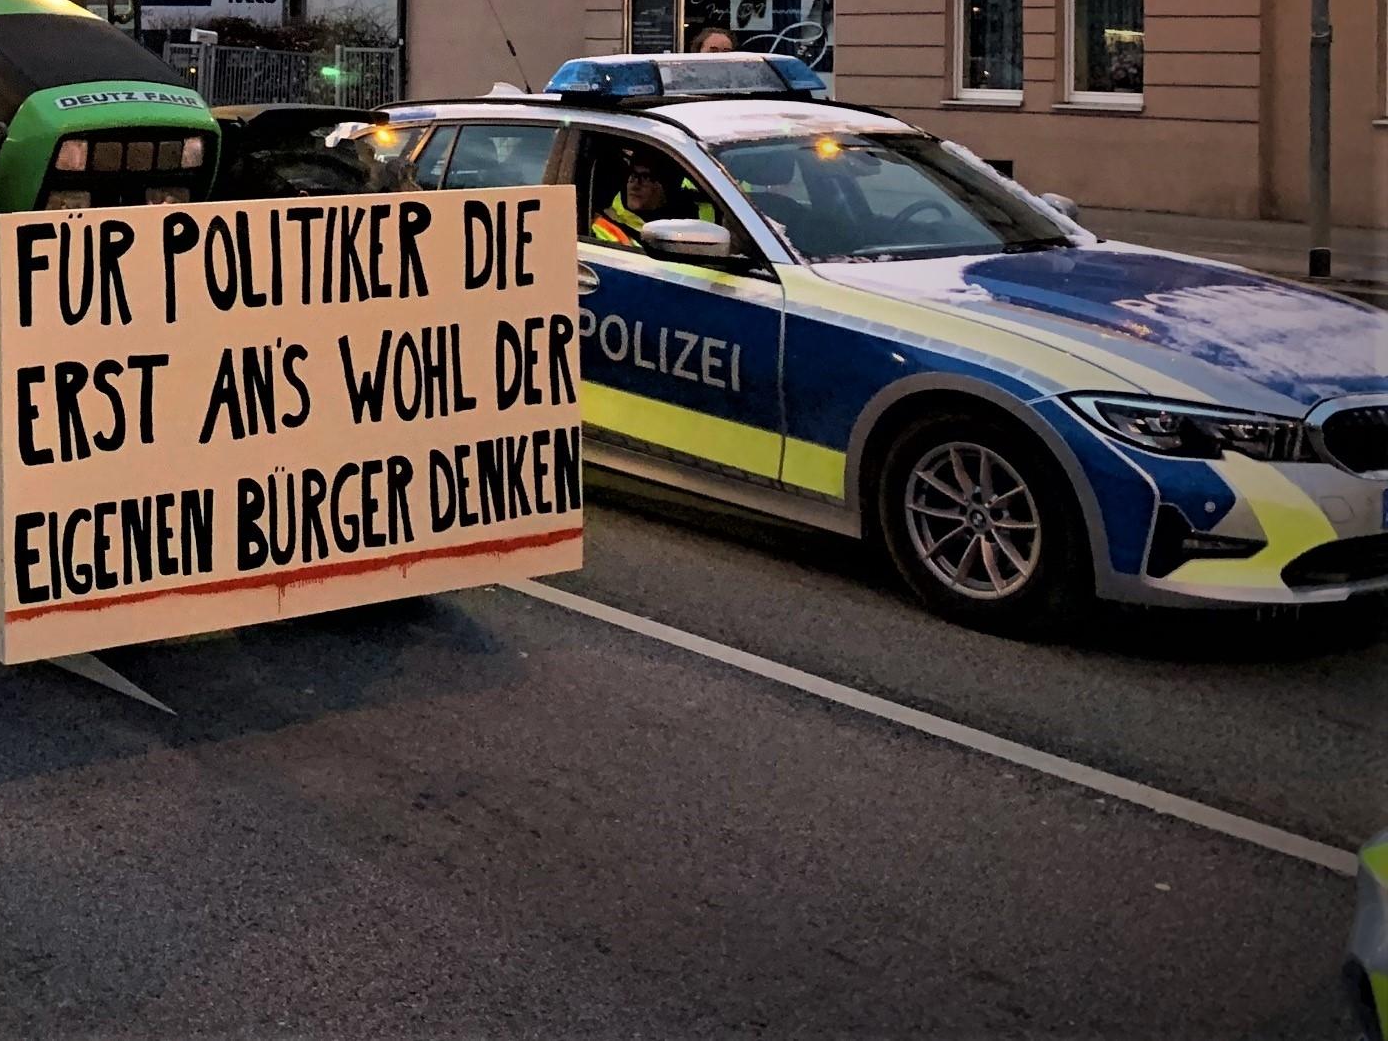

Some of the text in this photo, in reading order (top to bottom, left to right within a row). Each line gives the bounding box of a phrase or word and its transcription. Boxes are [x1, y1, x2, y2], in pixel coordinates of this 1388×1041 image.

[60, 91, 199, 108] DEUTZ FAHR
[15, 199, 541, 327] FÜR POLITIKER DIE
[16, 313, 577, 467] ERST AN'S WOHL DER
[14, 426, 582, 605] EIGENEN BÜRGER DENKEN
